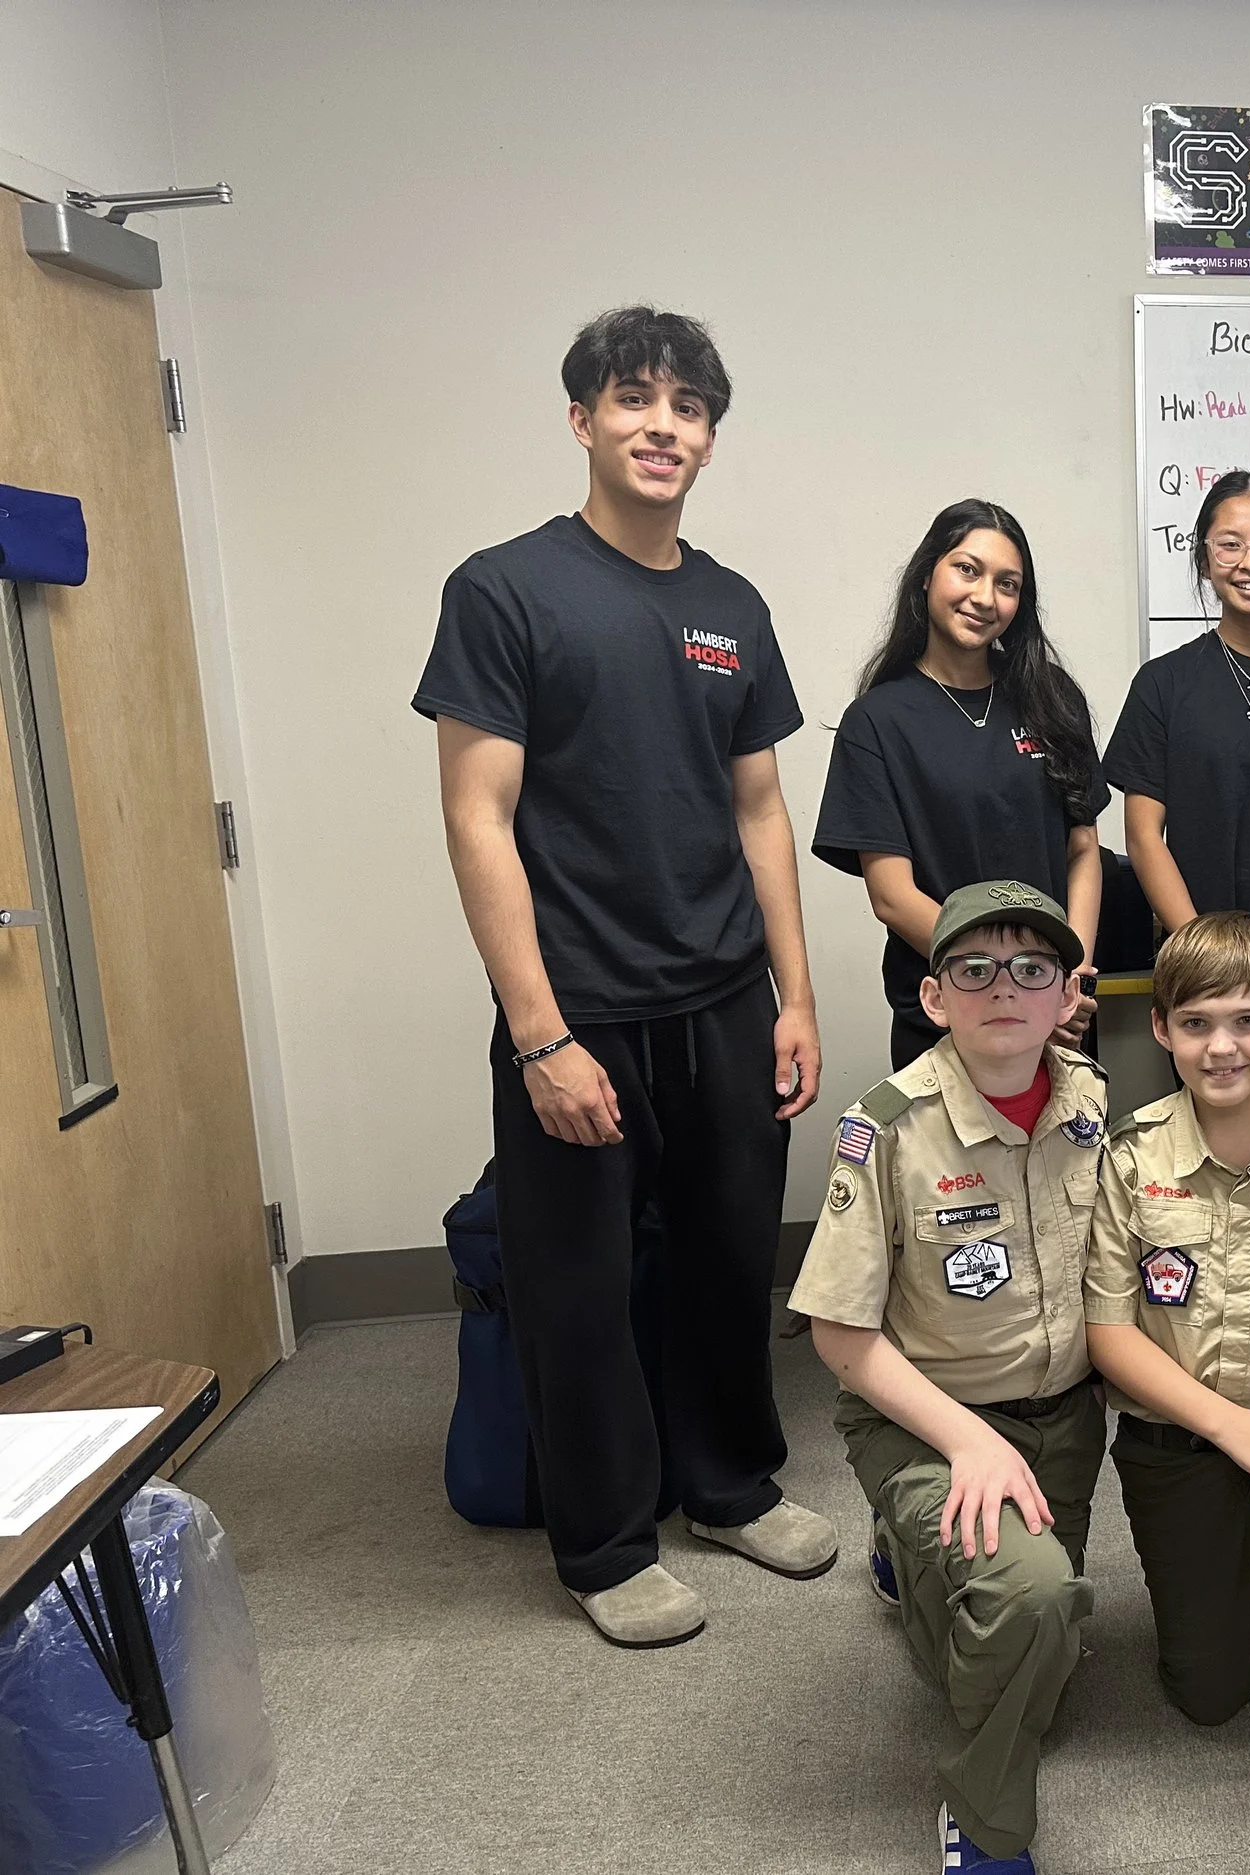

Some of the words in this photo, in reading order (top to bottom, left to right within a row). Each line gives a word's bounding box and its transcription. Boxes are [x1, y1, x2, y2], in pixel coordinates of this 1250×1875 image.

[1196, 258, 1228, 268] COMES
[1160, 394, 1202, 422] HW:
[1205, 390, 1247, 419] Read
[1160, 464, 1189, 496] Q:
[684, 627, 738, 654] LAMBERT
[685, 643, 740, 670] HOSA
[698, 662, 732, 676] 2024-2025
[955, 1172, 986, 1191] BSA
[1164, 1187, 1193, 1200] BSA
[950, 1210, 972, 1221] BRETT
[976, 1207, 998, 1218] HIRES
